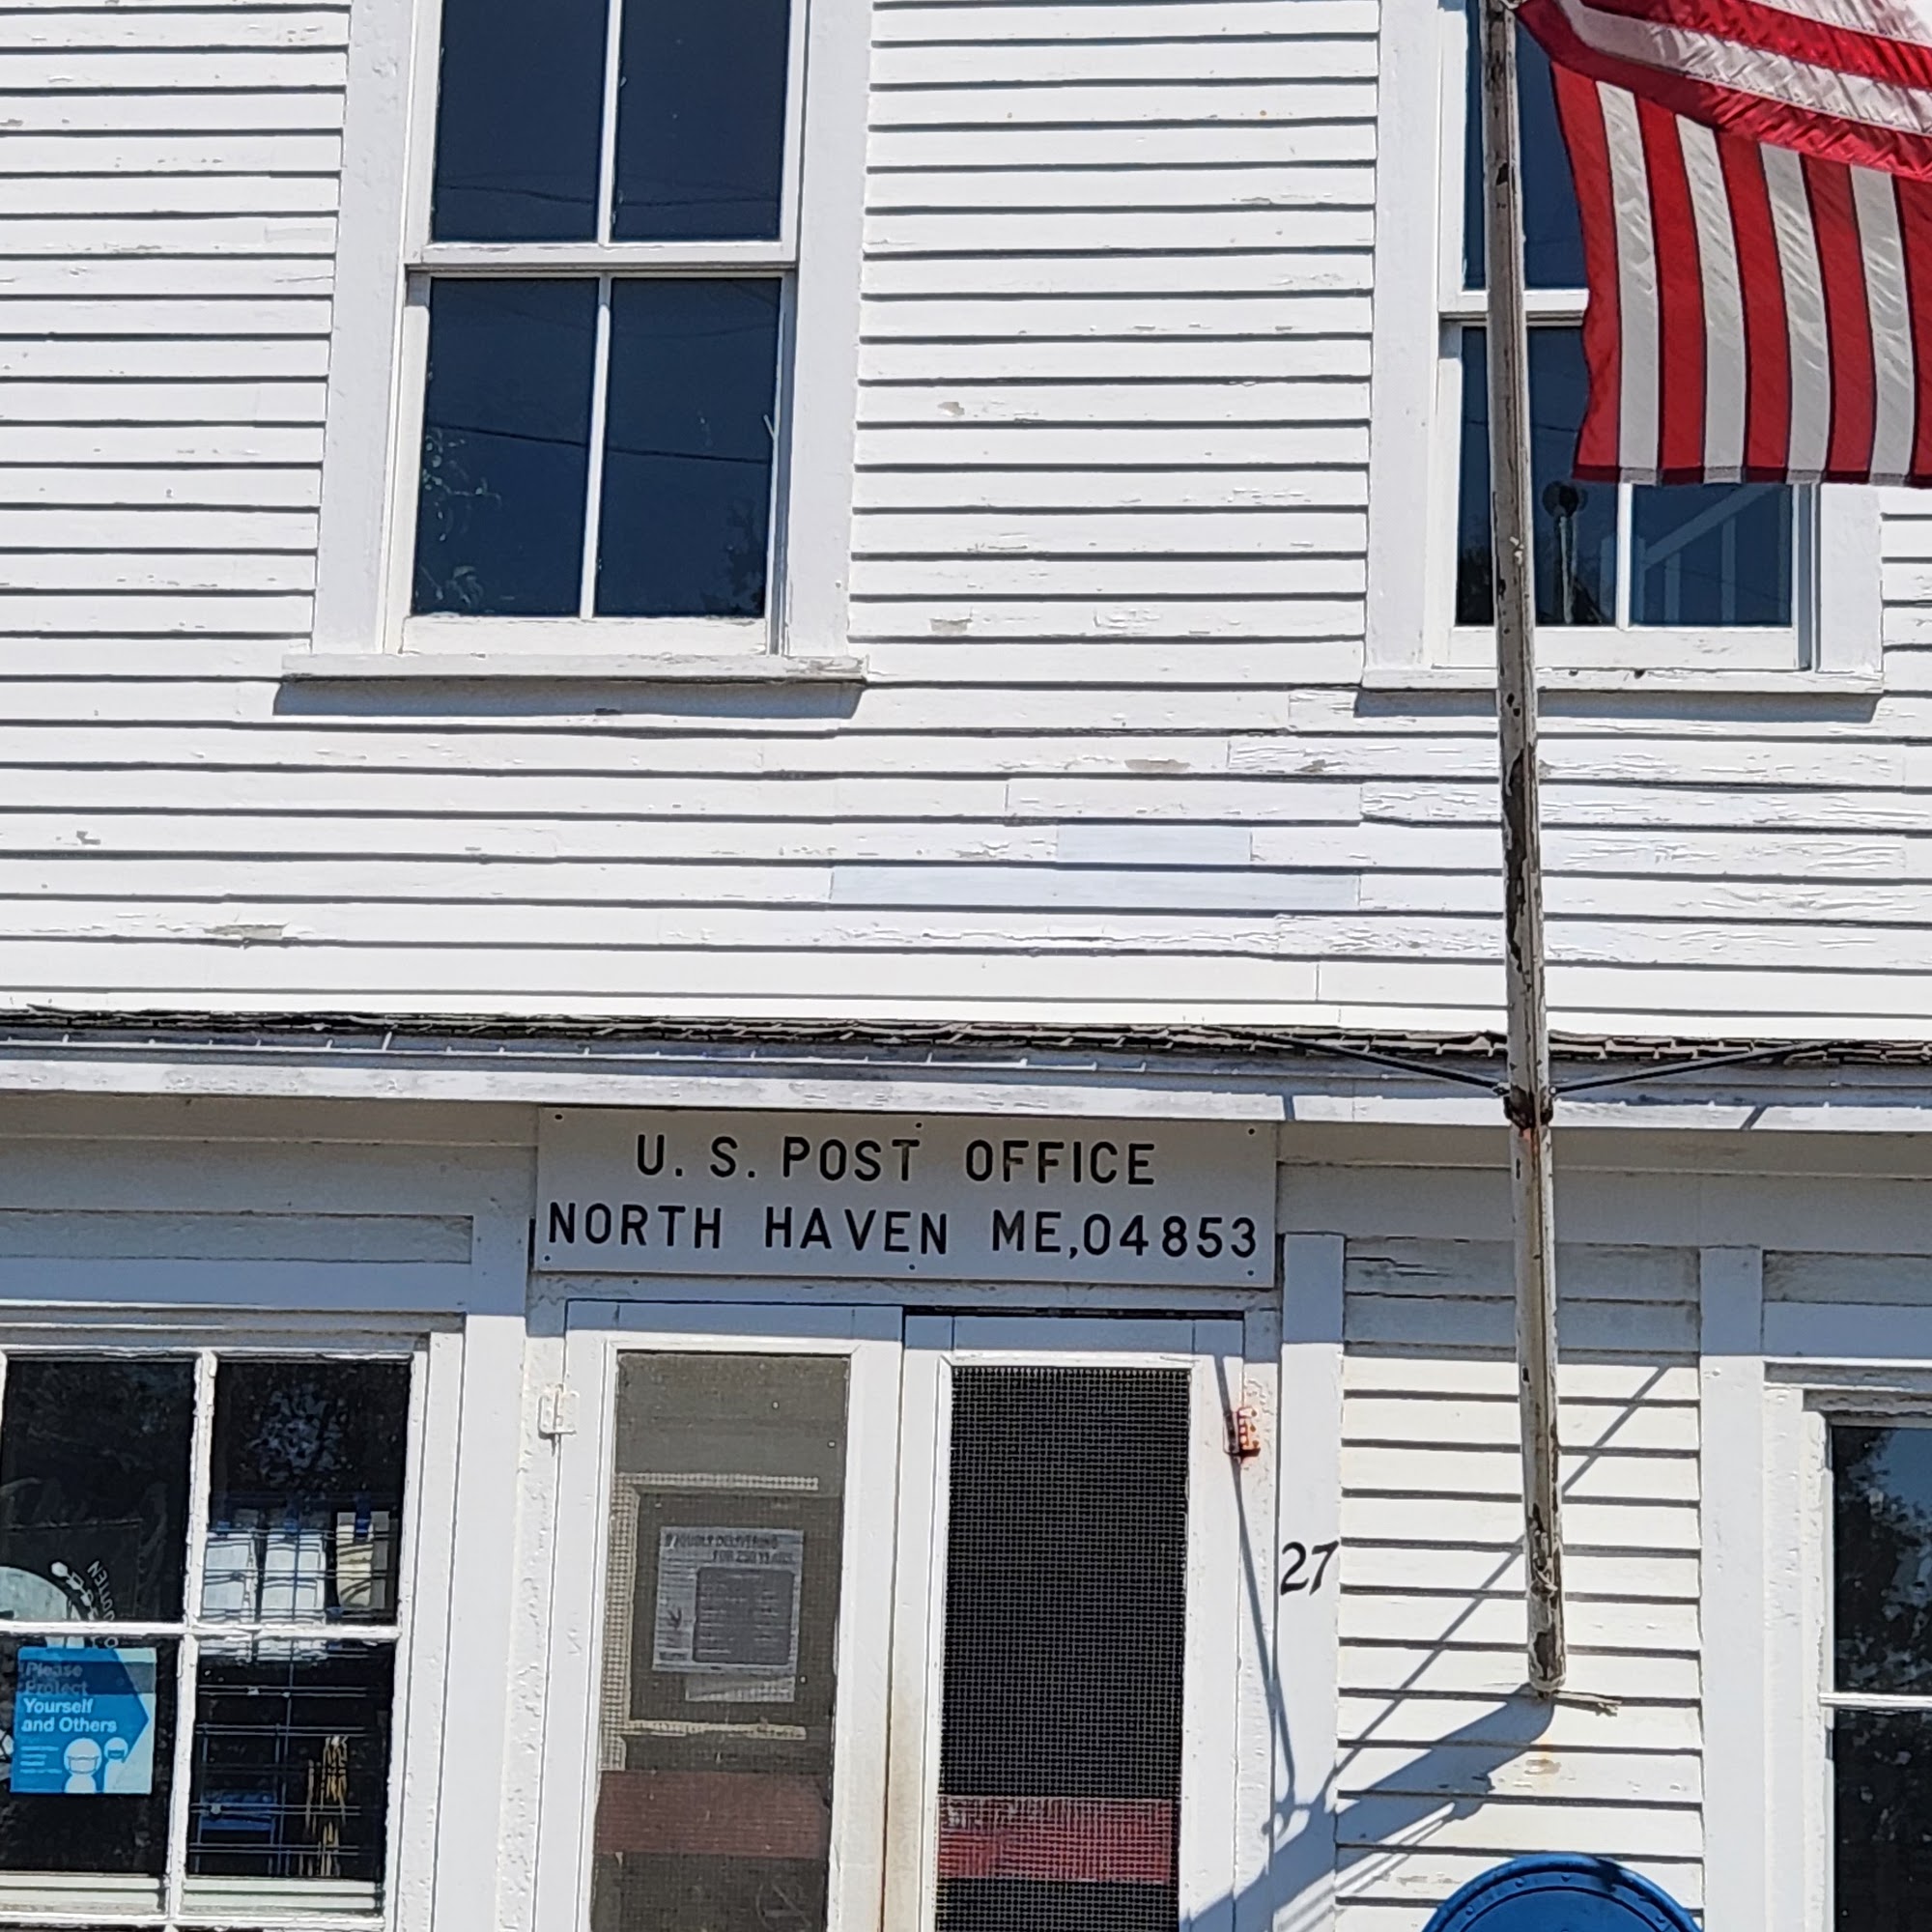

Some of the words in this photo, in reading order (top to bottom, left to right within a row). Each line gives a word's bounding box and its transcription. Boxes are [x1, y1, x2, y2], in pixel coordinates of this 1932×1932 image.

[636, 1132, 684, 1178] U.
[708, 1134, 756, 1179] S.
[781, 1135, 922, 1182] POST
[964, 1138, 1156, 1186] OFFICE
[548, 1201, 723, 1249] NORTH
[764, 1206, 948, 1256] HAVEN
[1280, 1540, 1340, 1596] 27
[25, 1662, 83, 1677] Please
[25, 1680, 89, 1696] Protect
[23, 1697, 94, 1714] Yourself
[21, 1717, 55, 1732] and
[59, 1717, 117, 1733] Others
